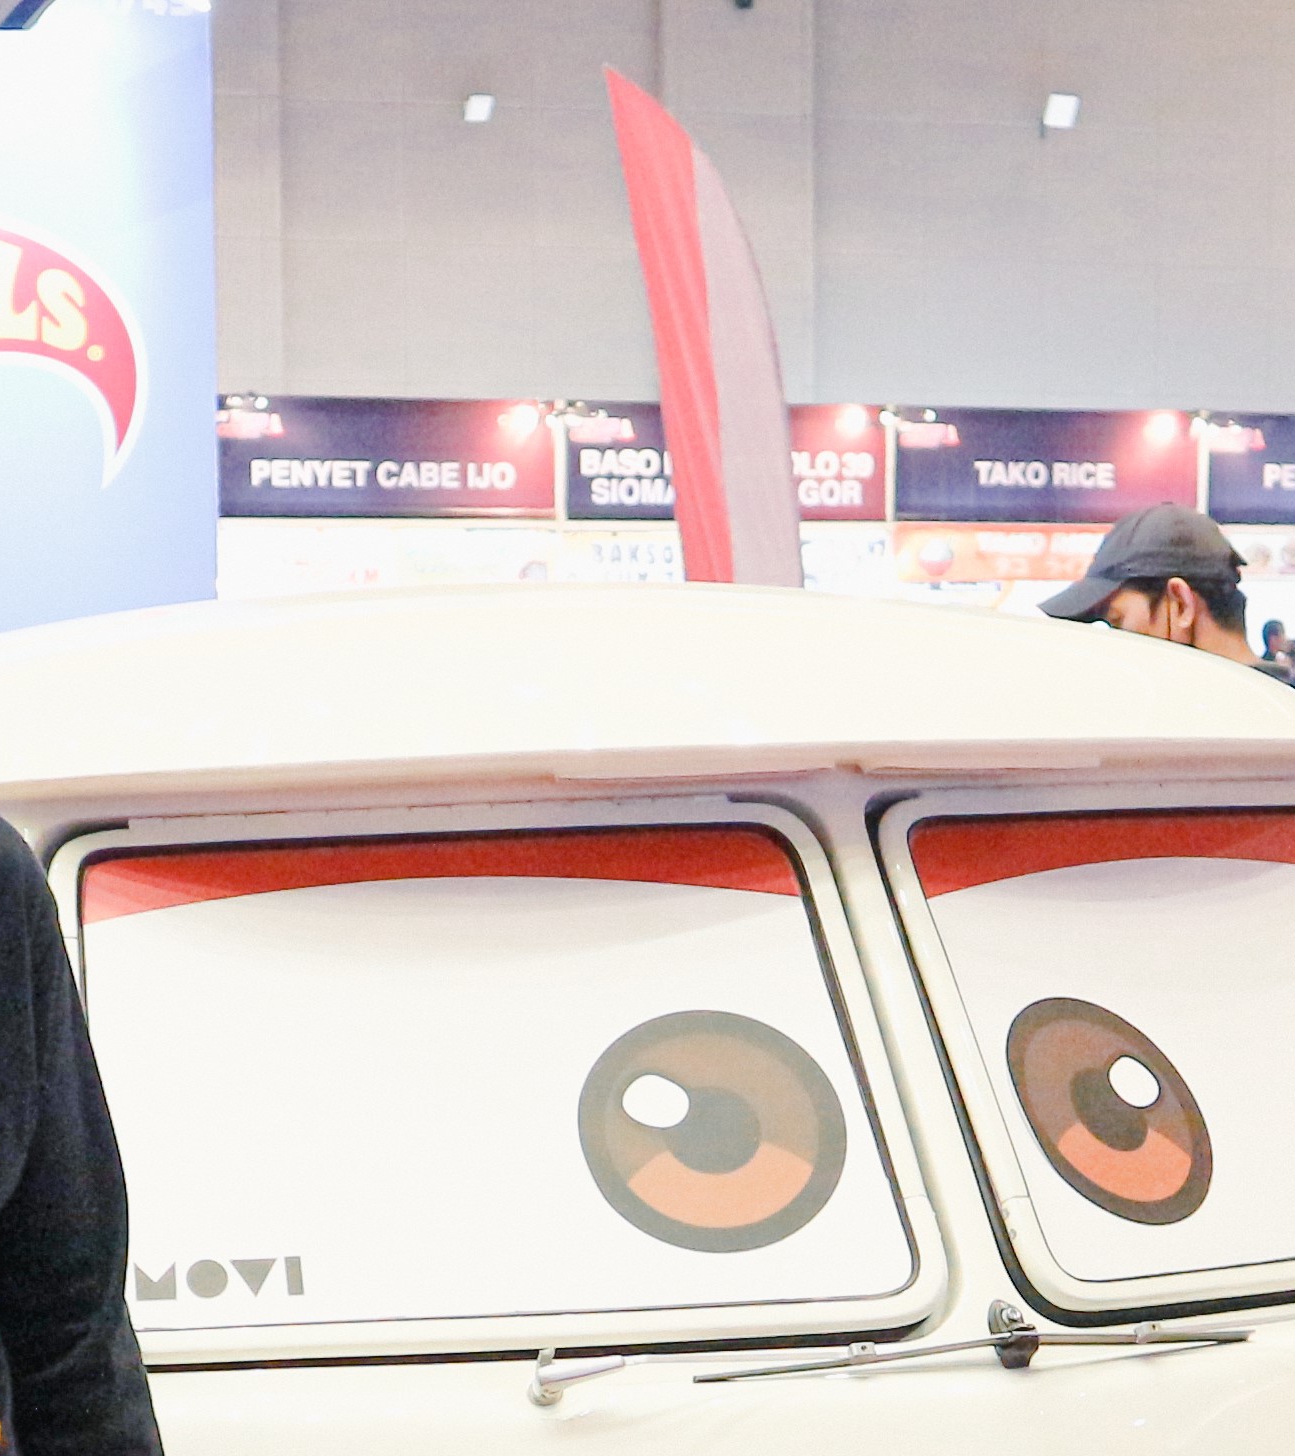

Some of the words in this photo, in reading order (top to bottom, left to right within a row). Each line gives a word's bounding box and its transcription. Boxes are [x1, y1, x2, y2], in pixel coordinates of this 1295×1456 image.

[250, 459, 371, 488] PENYET
[375, 460, 461, 489] CABE
[467, 461, 517, 490] IJO
[579, 448, 661, 478] BASO
[974, 460, 1049, 488] TAKO
[1052, 461, 1116, 489] RICE
[590, 477, 677, 505] SIOMA
[798, 480, 864, 506] GOR
[134, 1256, 305, 1301] MOVI
